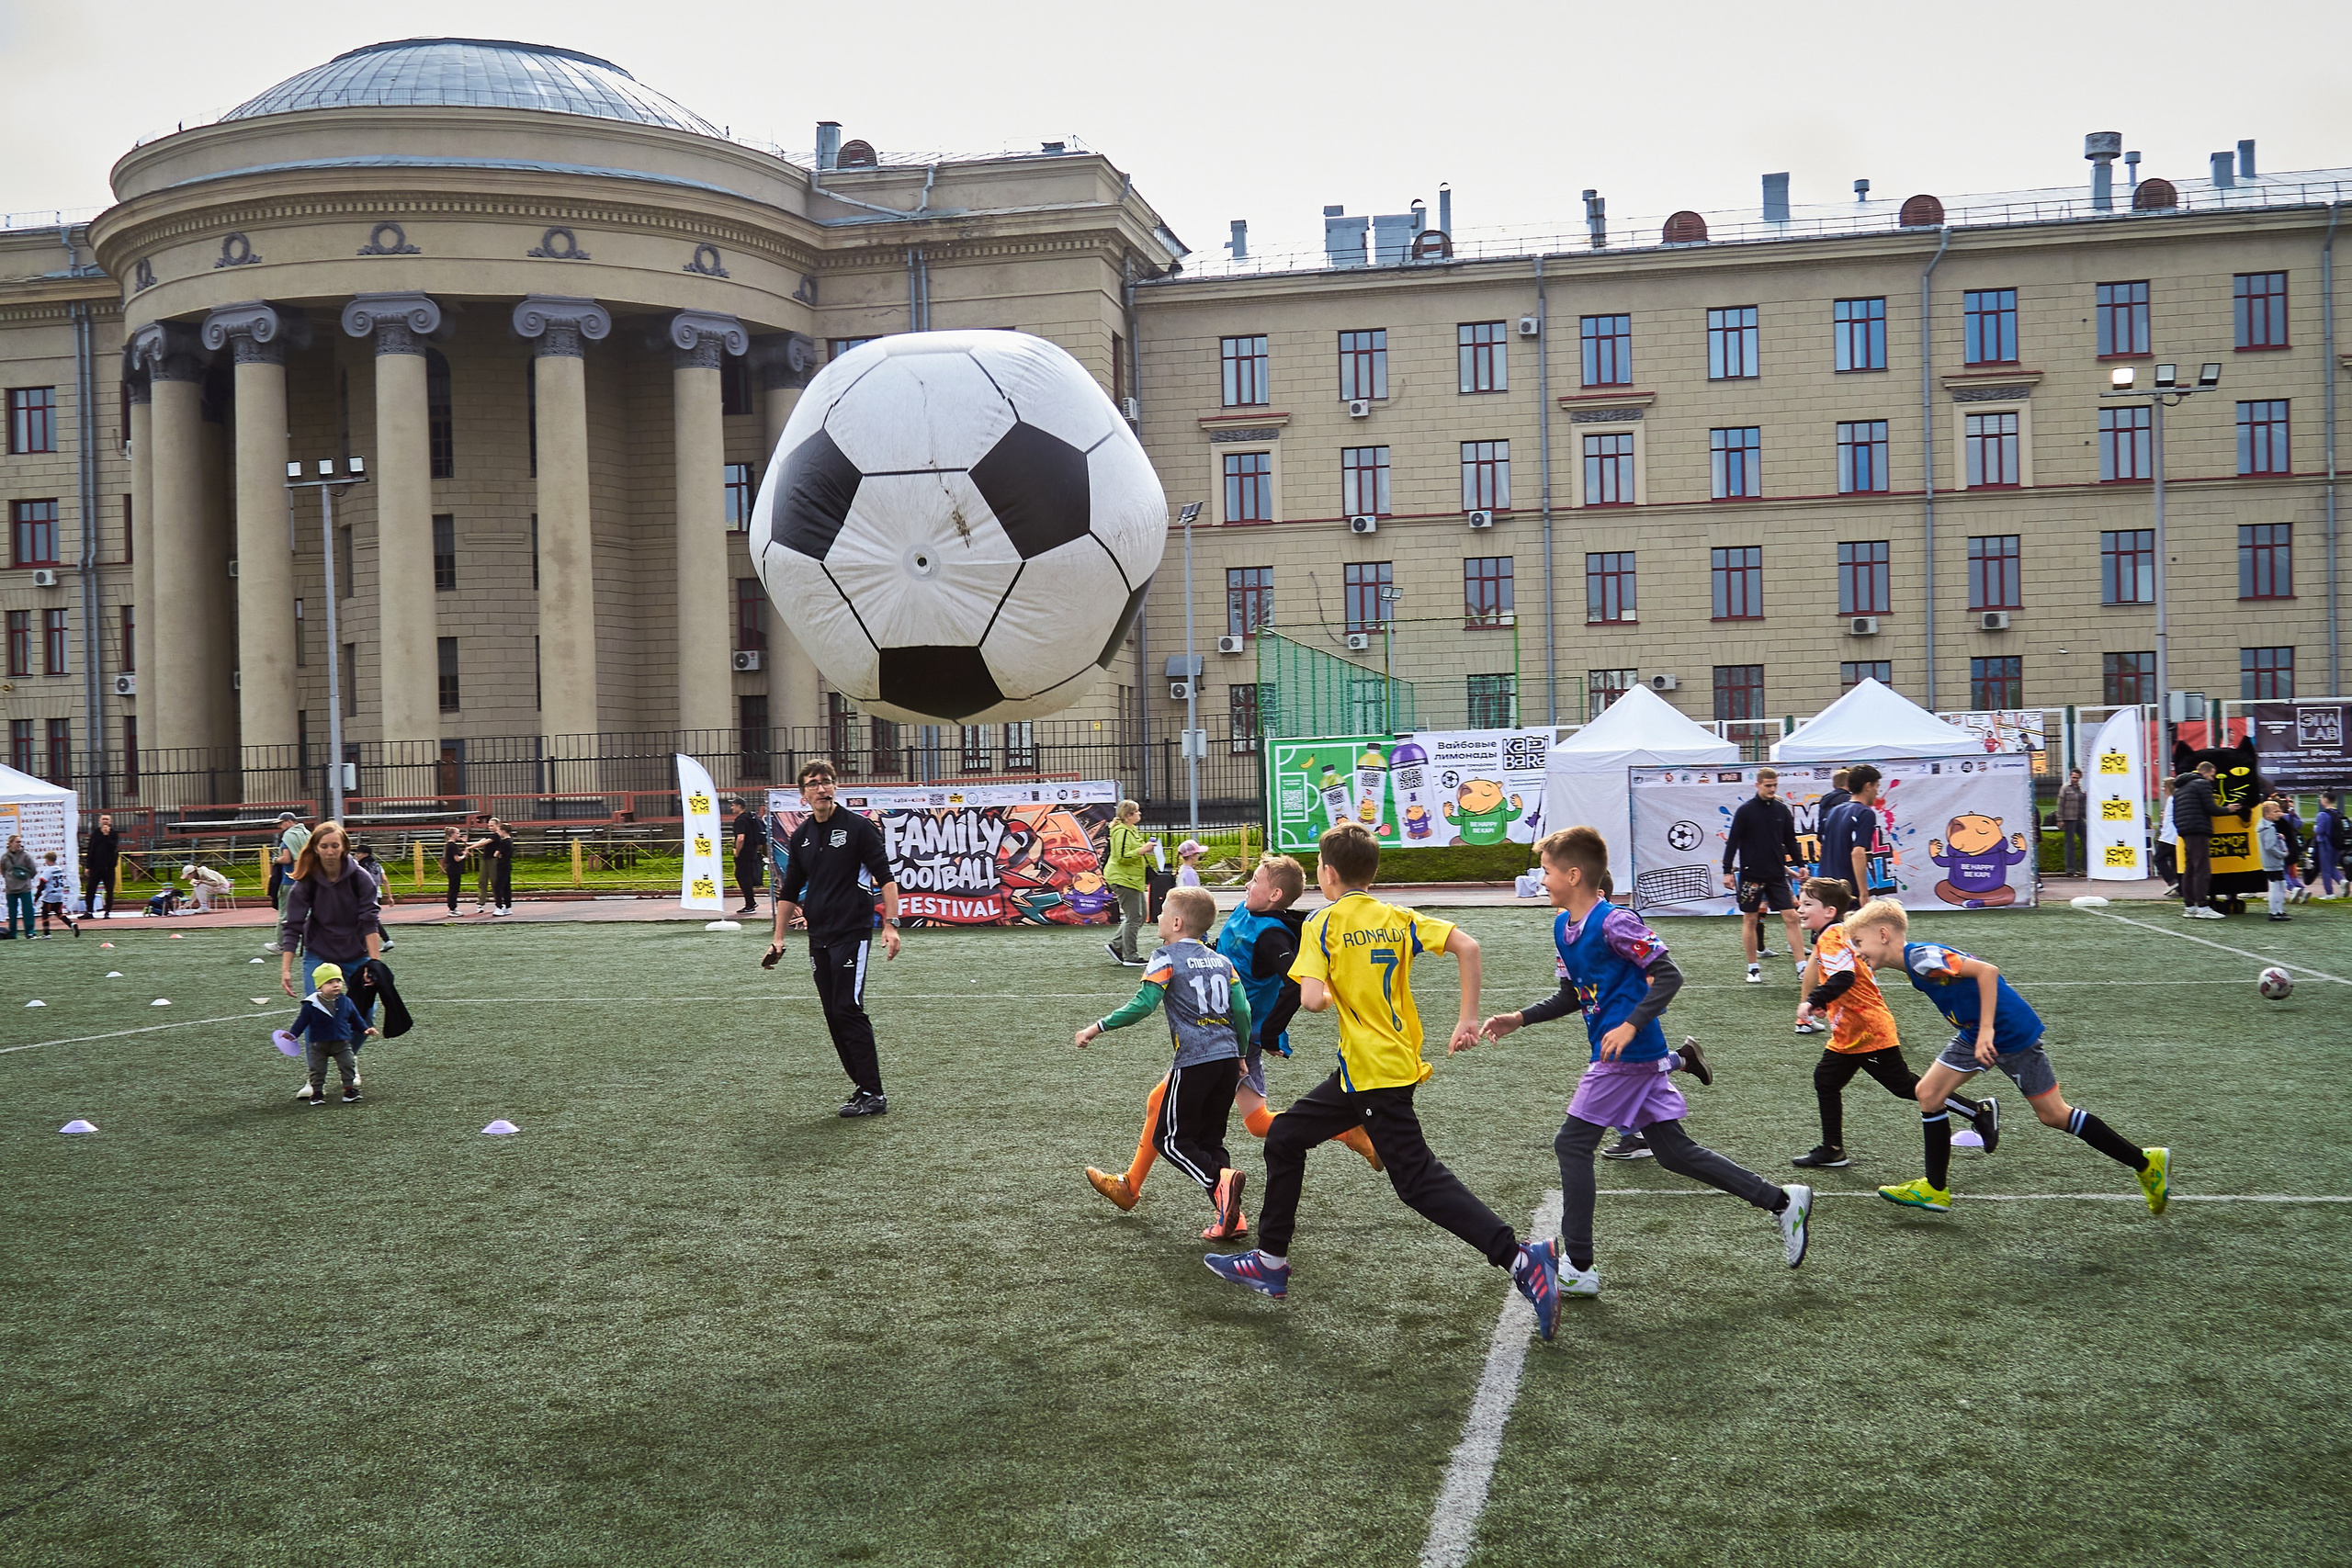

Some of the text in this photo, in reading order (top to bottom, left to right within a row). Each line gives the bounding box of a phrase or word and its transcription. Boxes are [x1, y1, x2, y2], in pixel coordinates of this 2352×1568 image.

[2301, 728, 2339, 740] LAB
[1437, 740, 1497, 750] Вайбовые
[1433, 751, 1498, 761] лимонады
[881, 809, 1006, 862] FAMILY
[888, 854, 1001, 892] FOOTBALL
[898, 897, 1001, 918] FESTIVAL
[1186, 956, 1225, 970] СПЕЦОВ
[1188, 973, 1230, 1015] 10
[1370, 948, 1402, 1032] 7
